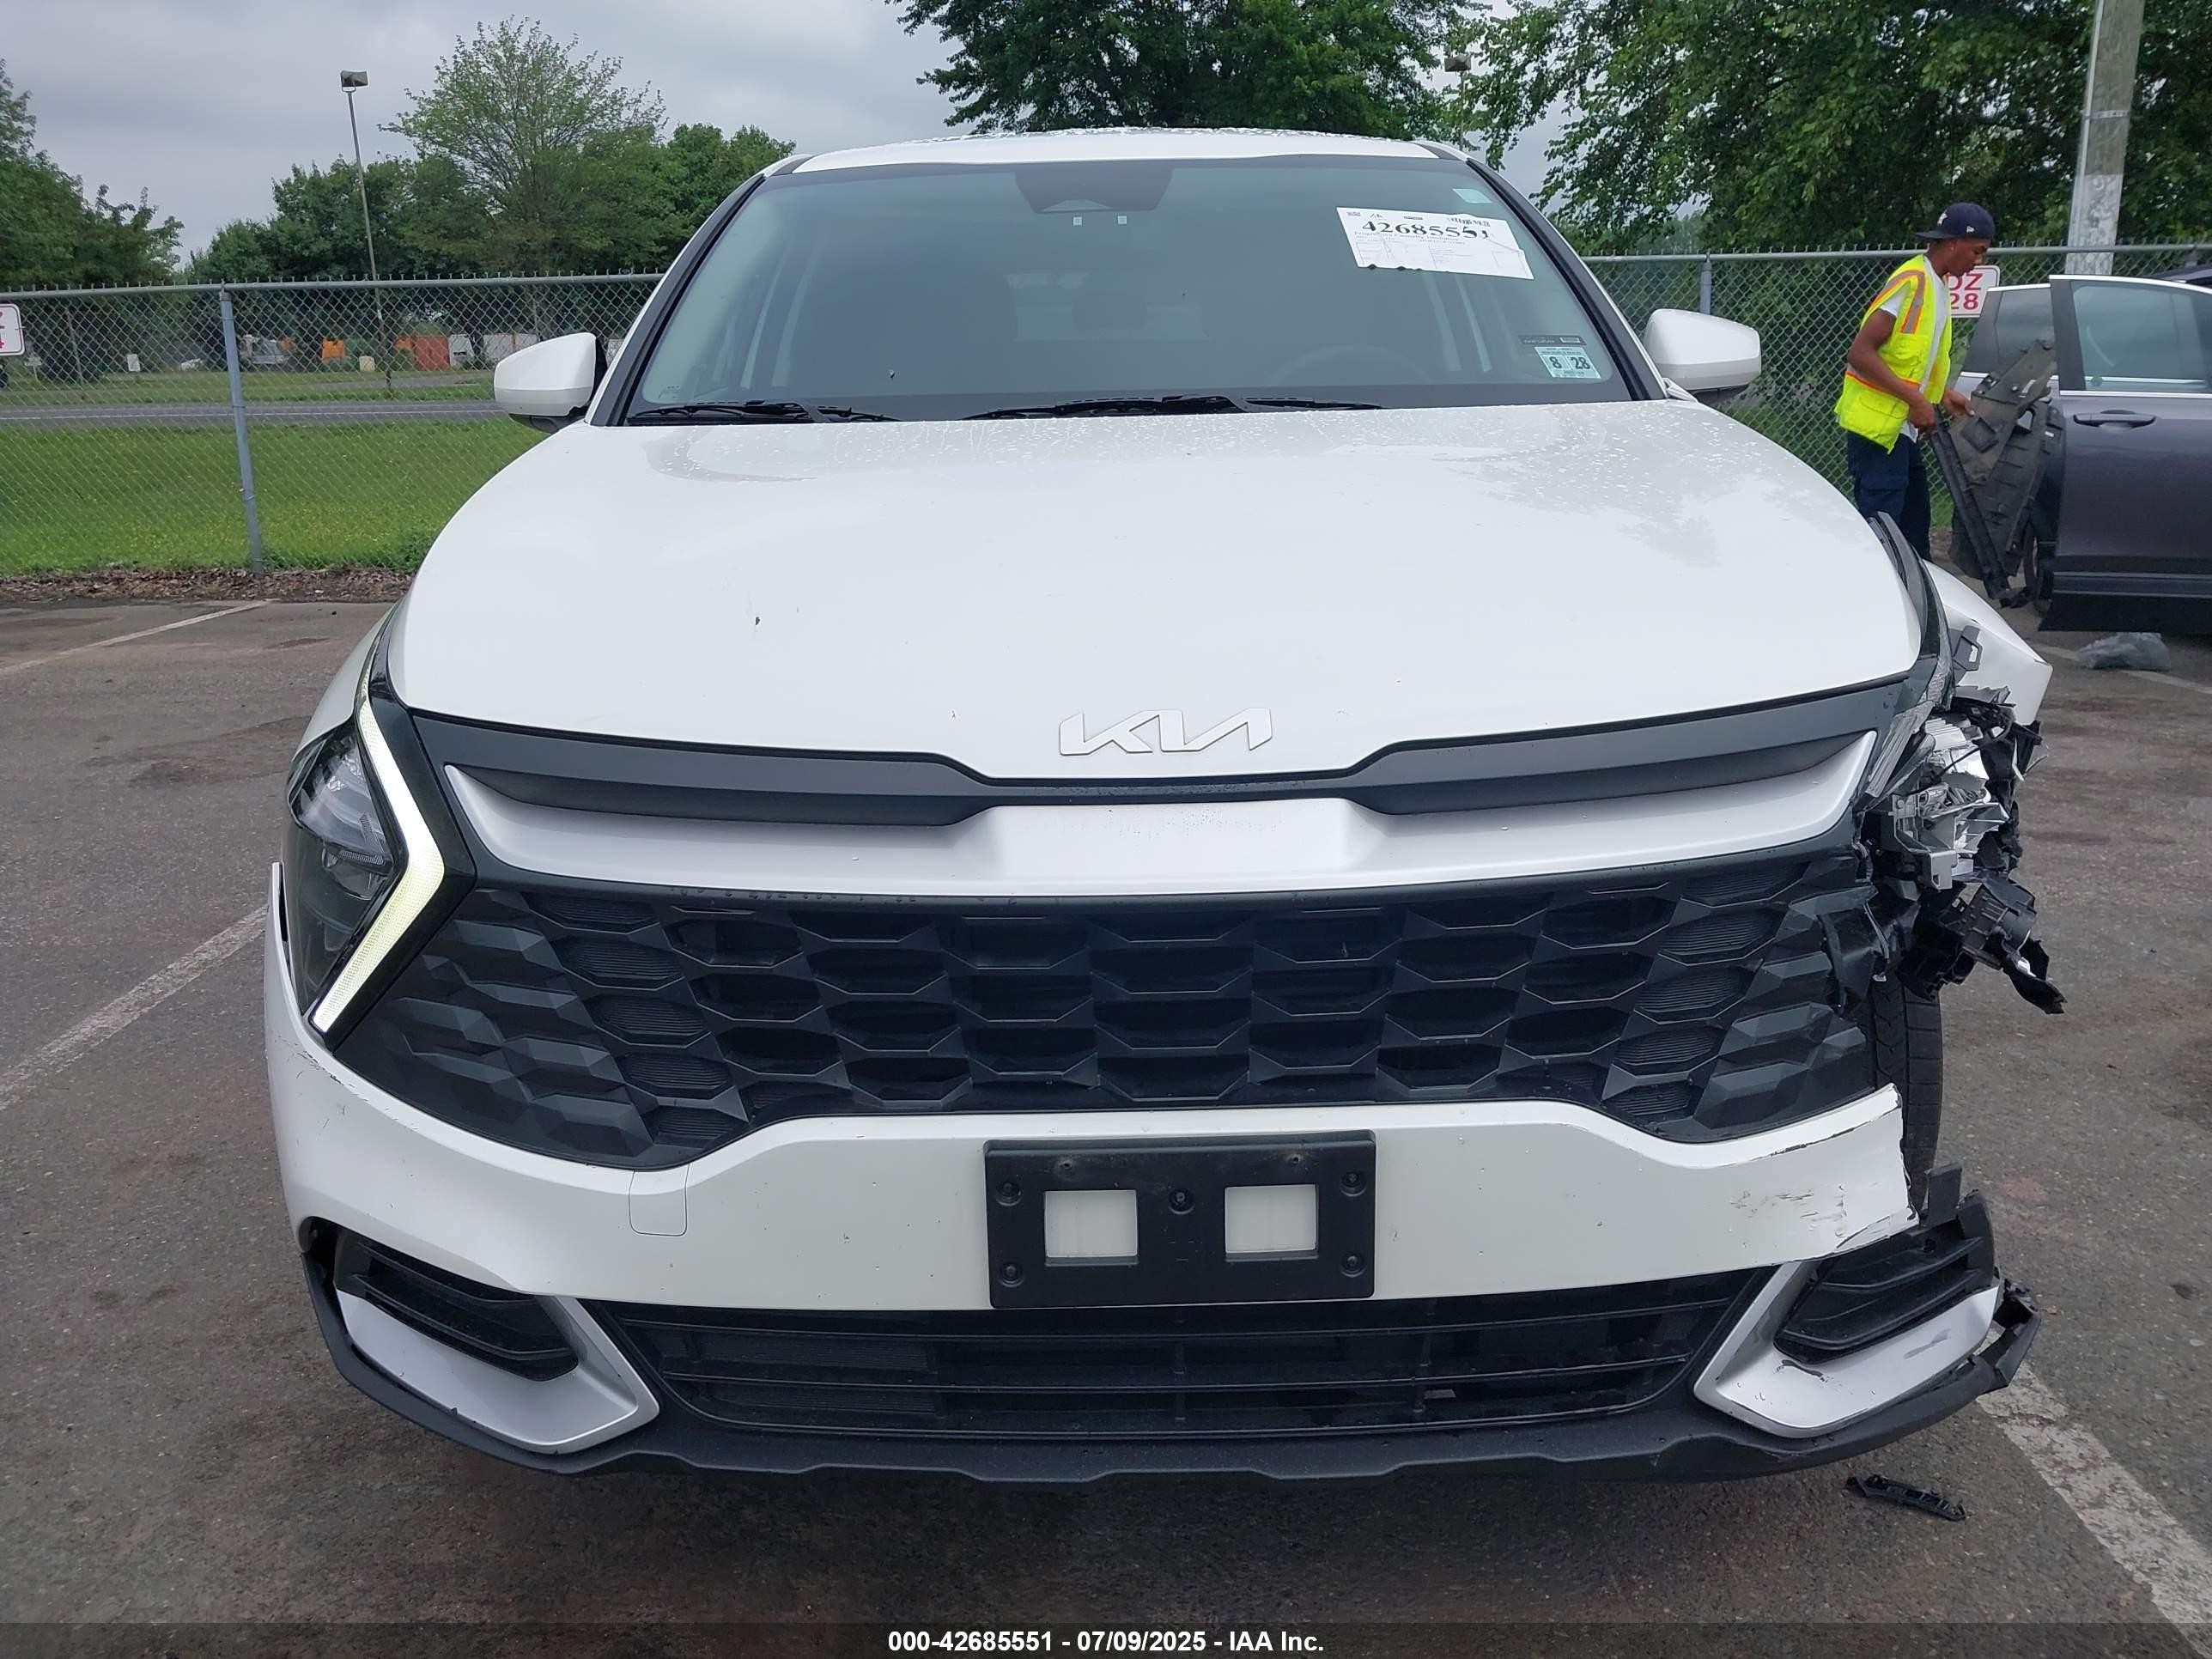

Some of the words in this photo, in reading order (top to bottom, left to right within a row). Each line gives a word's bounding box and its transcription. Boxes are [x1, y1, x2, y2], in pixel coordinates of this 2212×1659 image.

[1949, 293, 1979, 310] 28
[1548, 356, 1562, 369] 8
[1570, 356, 1591, 370] 28
